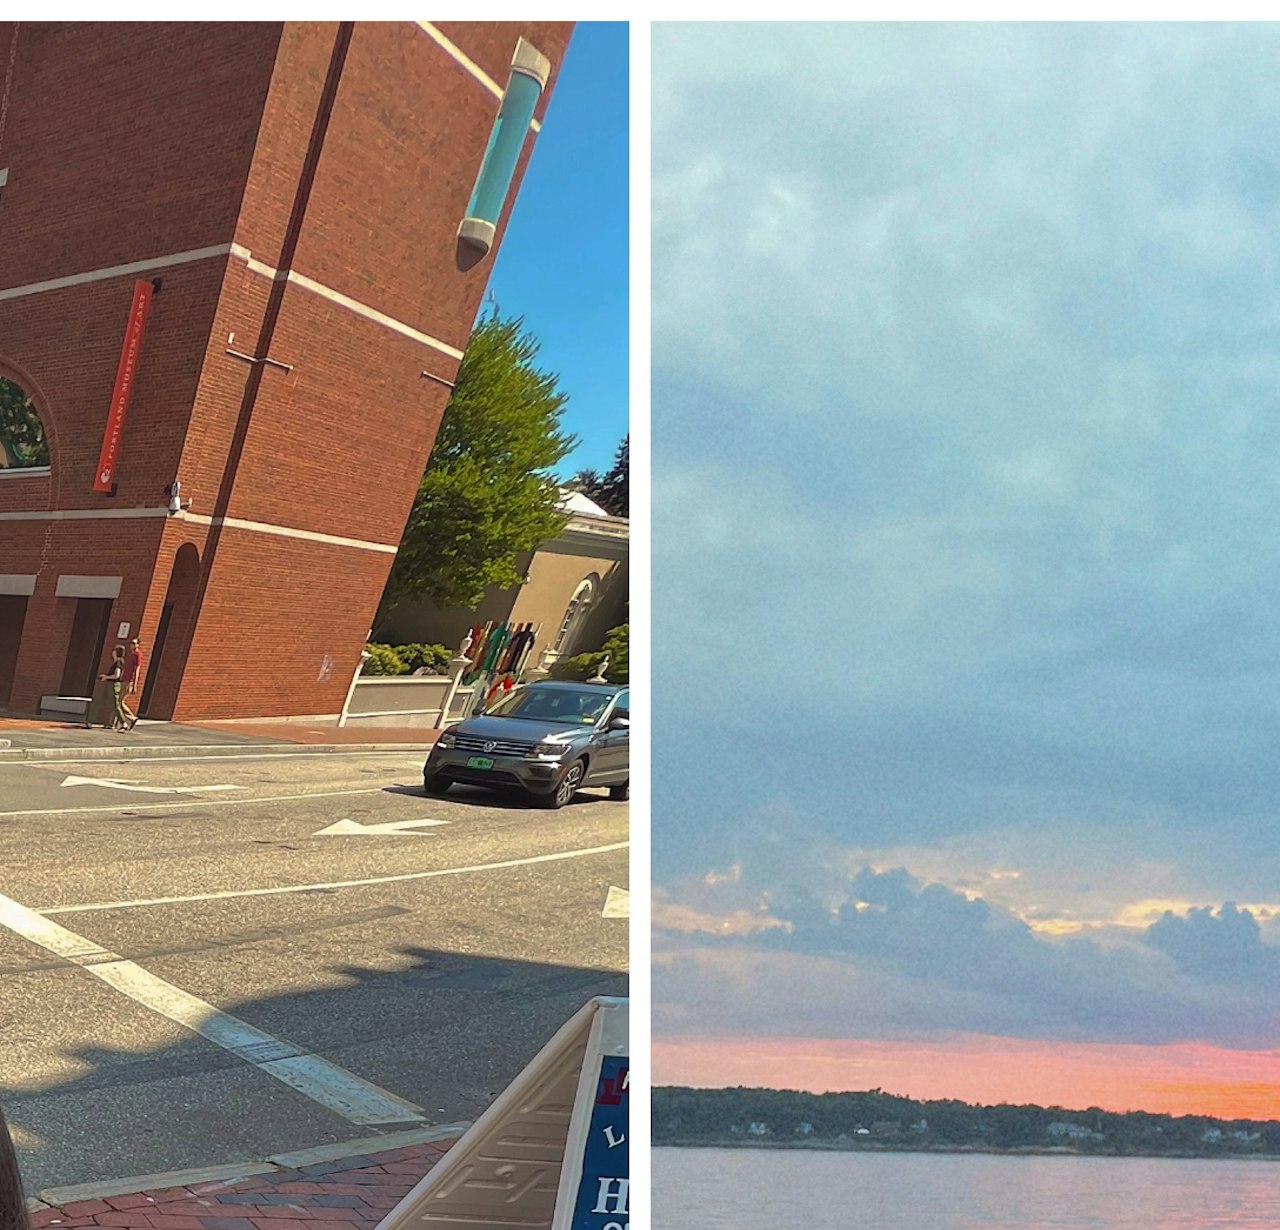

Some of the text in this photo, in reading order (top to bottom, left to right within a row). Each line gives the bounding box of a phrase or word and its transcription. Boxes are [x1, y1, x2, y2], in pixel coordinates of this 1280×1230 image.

[109, 397, 125, 460] PORTLAND
[122, 338, 137, 392] MUSEUM
[137, 294, 147, 321] ART
